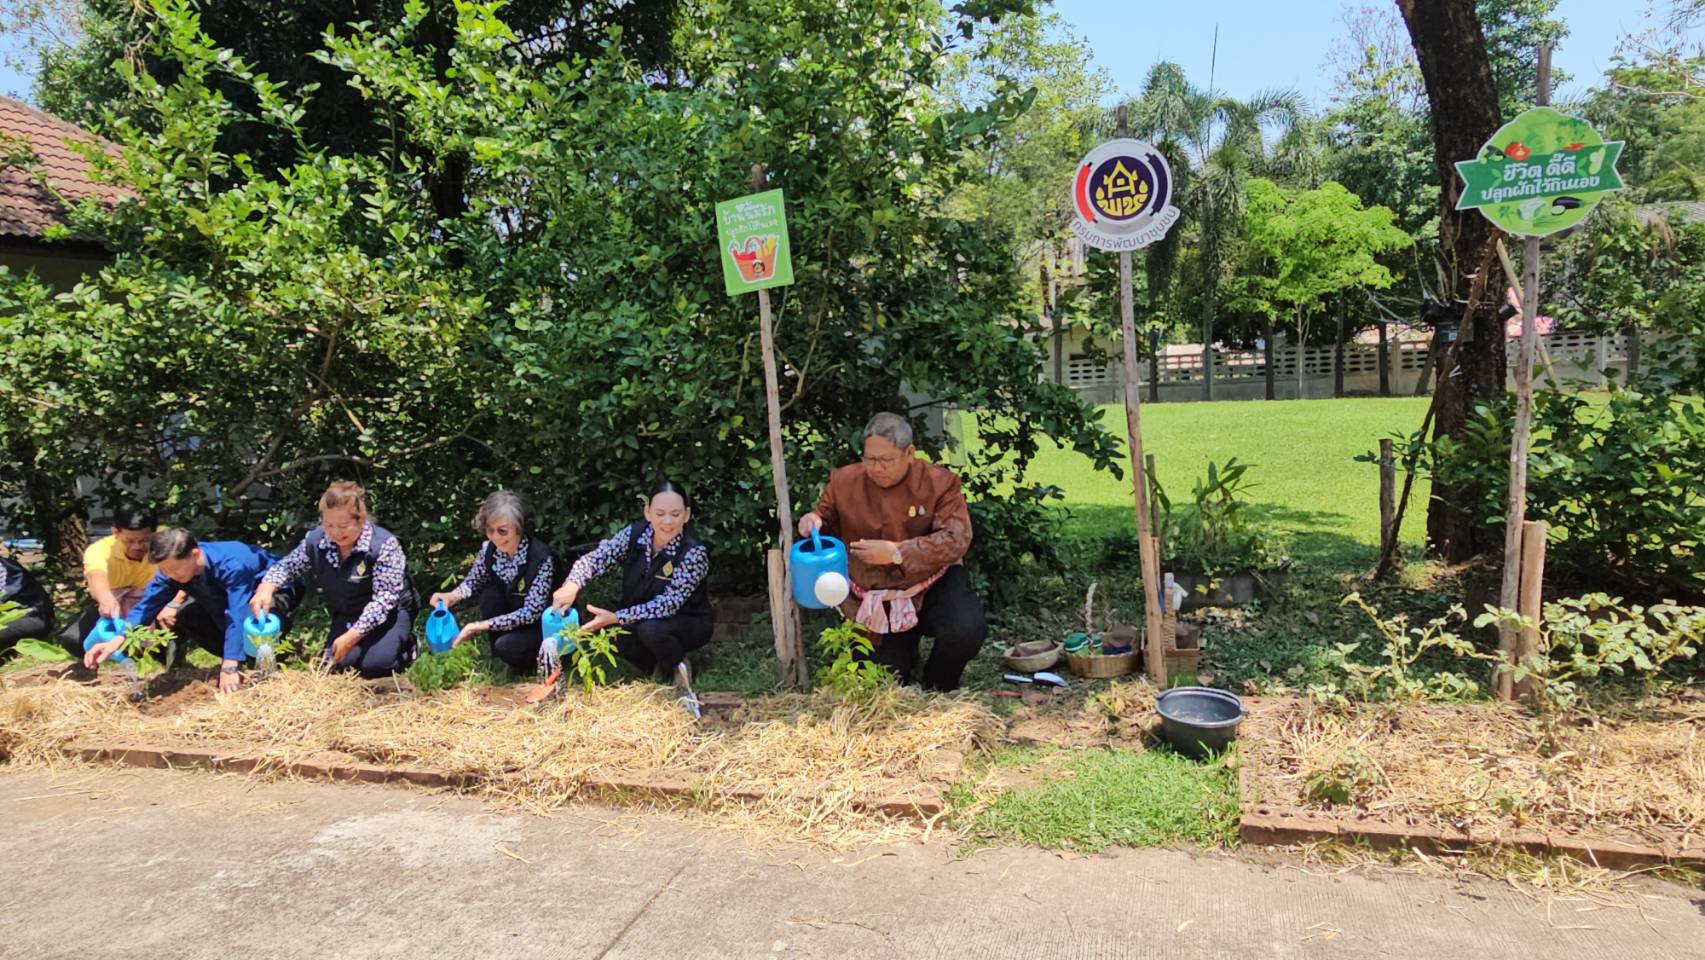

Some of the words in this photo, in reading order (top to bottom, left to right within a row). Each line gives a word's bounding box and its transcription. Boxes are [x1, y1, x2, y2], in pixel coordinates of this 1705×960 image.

[1503, 163, 1543, 181] ชีวิต
[1481, 176, 1600, 203] ปลูกผักไว้กินเอง
[1072, 208, 1177, 249] กรมการพัฒนาชุมชน
